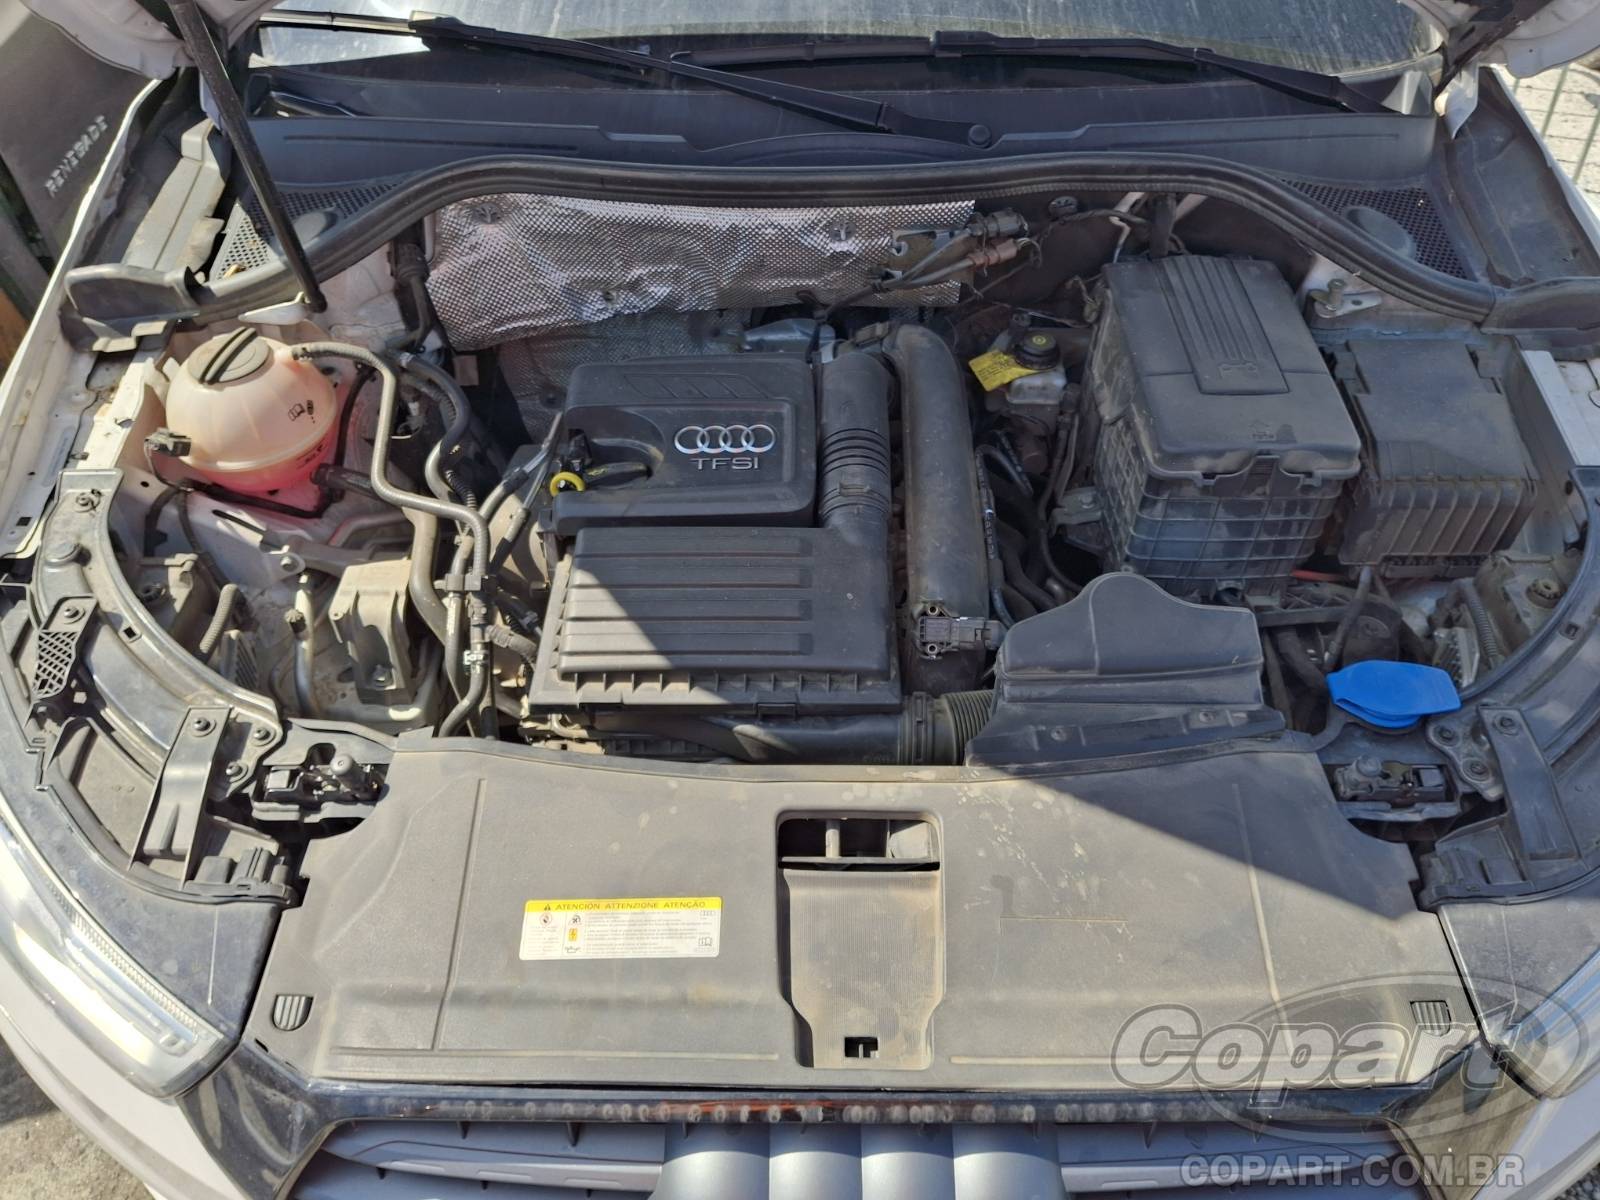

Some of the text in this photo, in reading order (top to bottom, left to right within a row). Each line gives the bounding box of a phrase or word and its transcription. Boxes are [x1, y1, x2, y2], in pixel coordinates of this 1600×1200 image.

[44, 115, 108, 198] RENEGADE
[691, 457, 759, 470] TFSI
[604, 901, 658, 910] ATTENZIONE
[663, 900, 706, 910] ATENÇÃO
